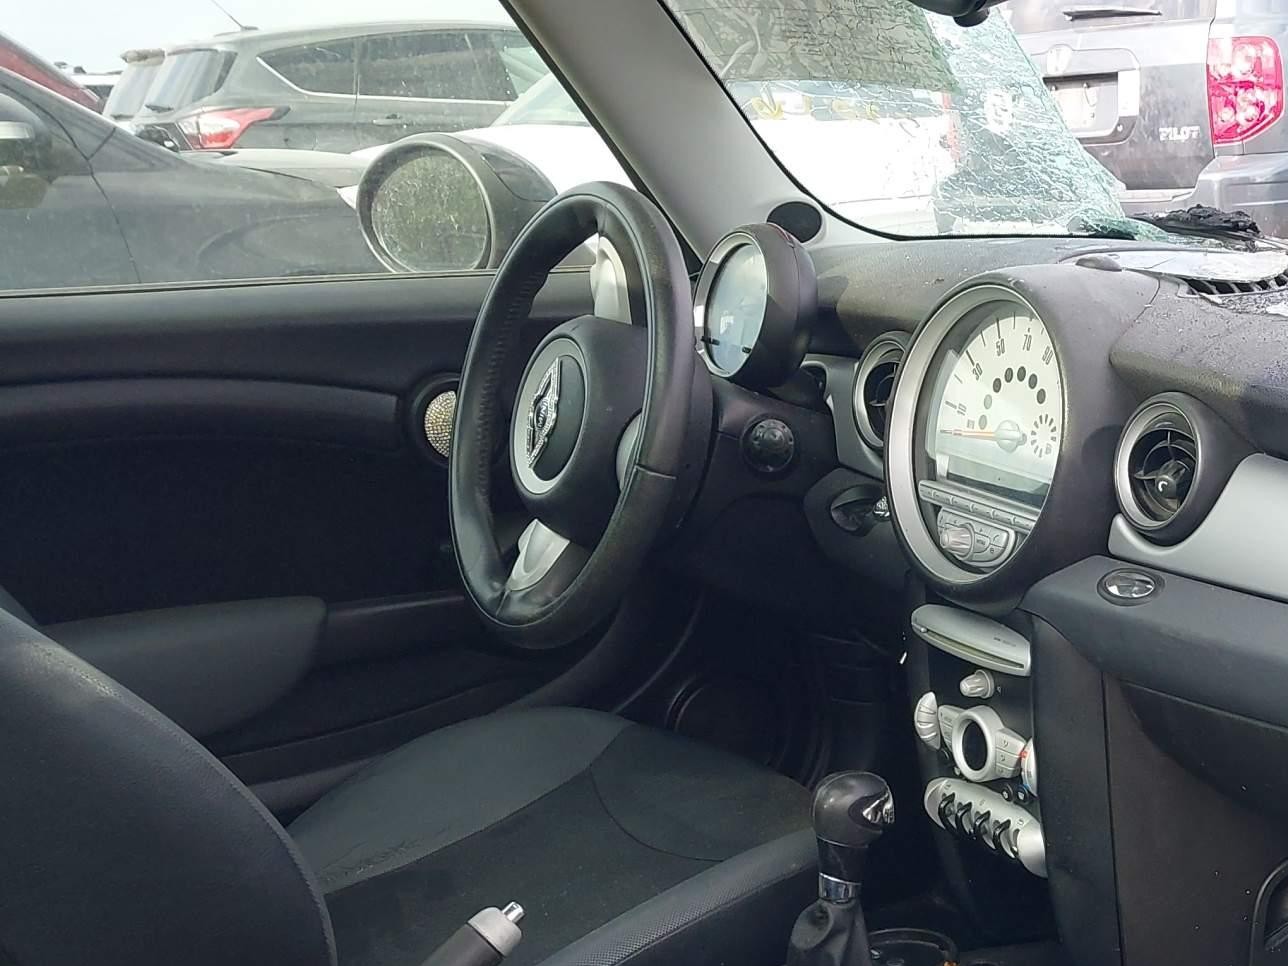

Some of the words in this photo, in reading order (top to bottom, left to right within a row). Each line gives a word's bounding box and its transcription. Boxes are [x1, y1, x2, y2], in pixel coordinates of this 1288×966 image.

[1159, 126, 1201, 142] PILOT
[995, 338, 1005, 356] 50
[1022, 334, 1032, 351] 70
[1042, 346, 1053, 365] 90
[972, 363, 983, 381] 30
